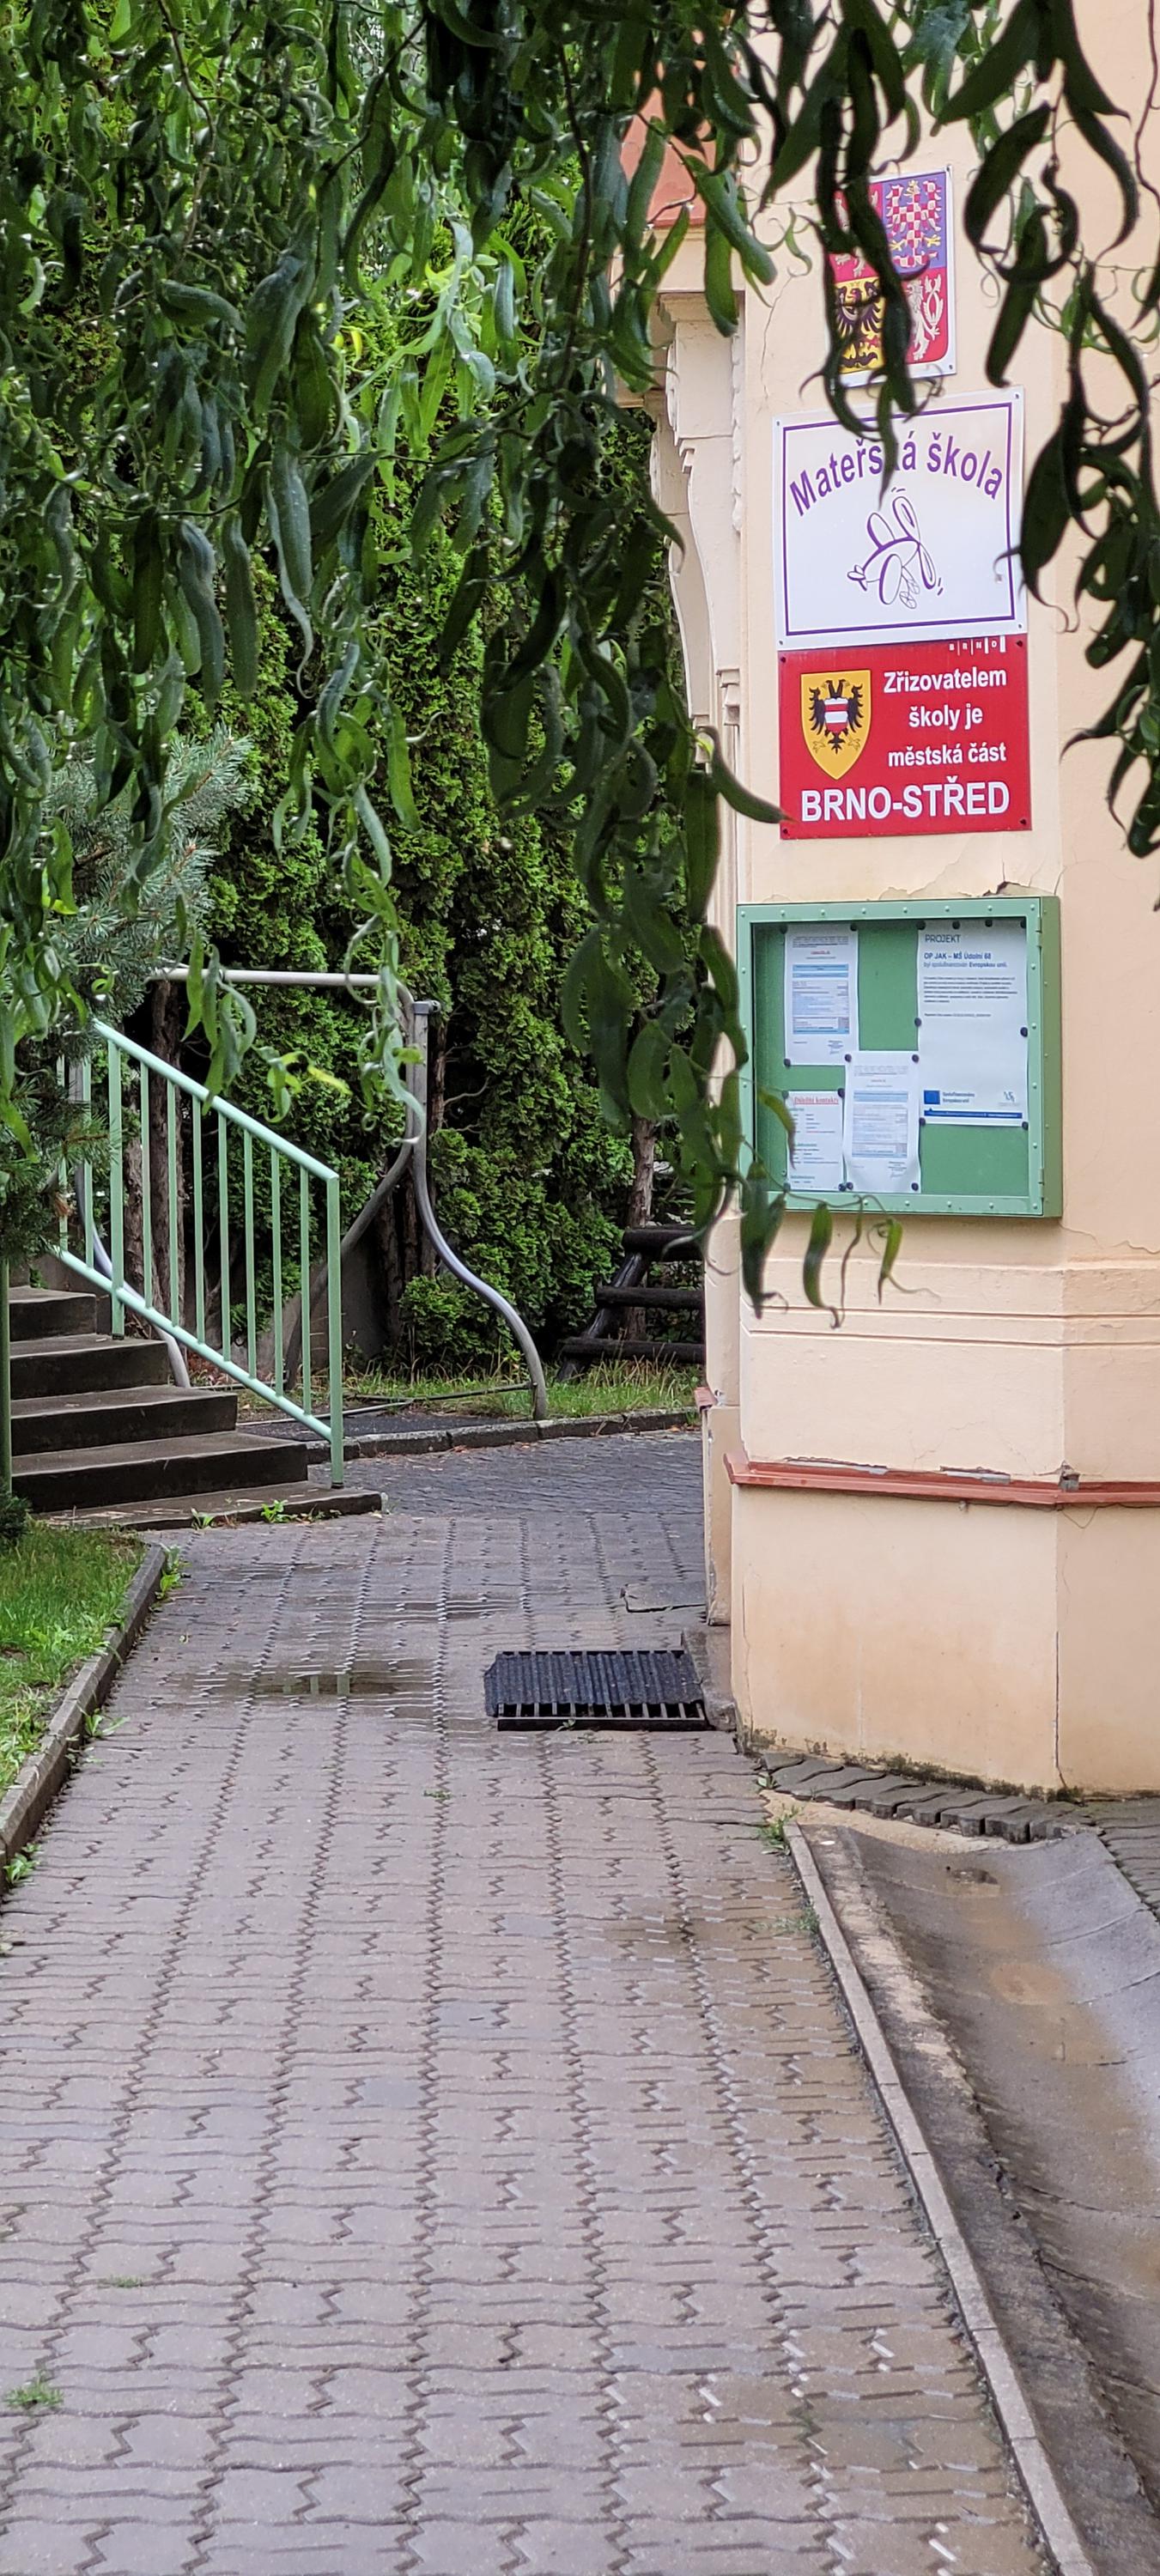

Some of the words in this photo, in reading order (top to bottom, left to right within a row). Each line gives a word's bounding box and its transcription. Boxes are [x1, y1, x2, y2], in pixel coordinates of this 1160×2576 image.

[789, 431, 916, 517] Mateřsá
[926, 432, 1004, 500] škola
[884, 666, 1007, 693] Zřizovatelem
[908, 704, 960, 731] školy
[964, 703, 983, 730] je
[888, 744, 963, 767] městská
[968, 742, 1006, 762] část
[801, 775, 1011, 822] BRNO-STŘED
[925, 934, 962, 943] PROJEKT
[953, 951, 963, 959] MŠ
